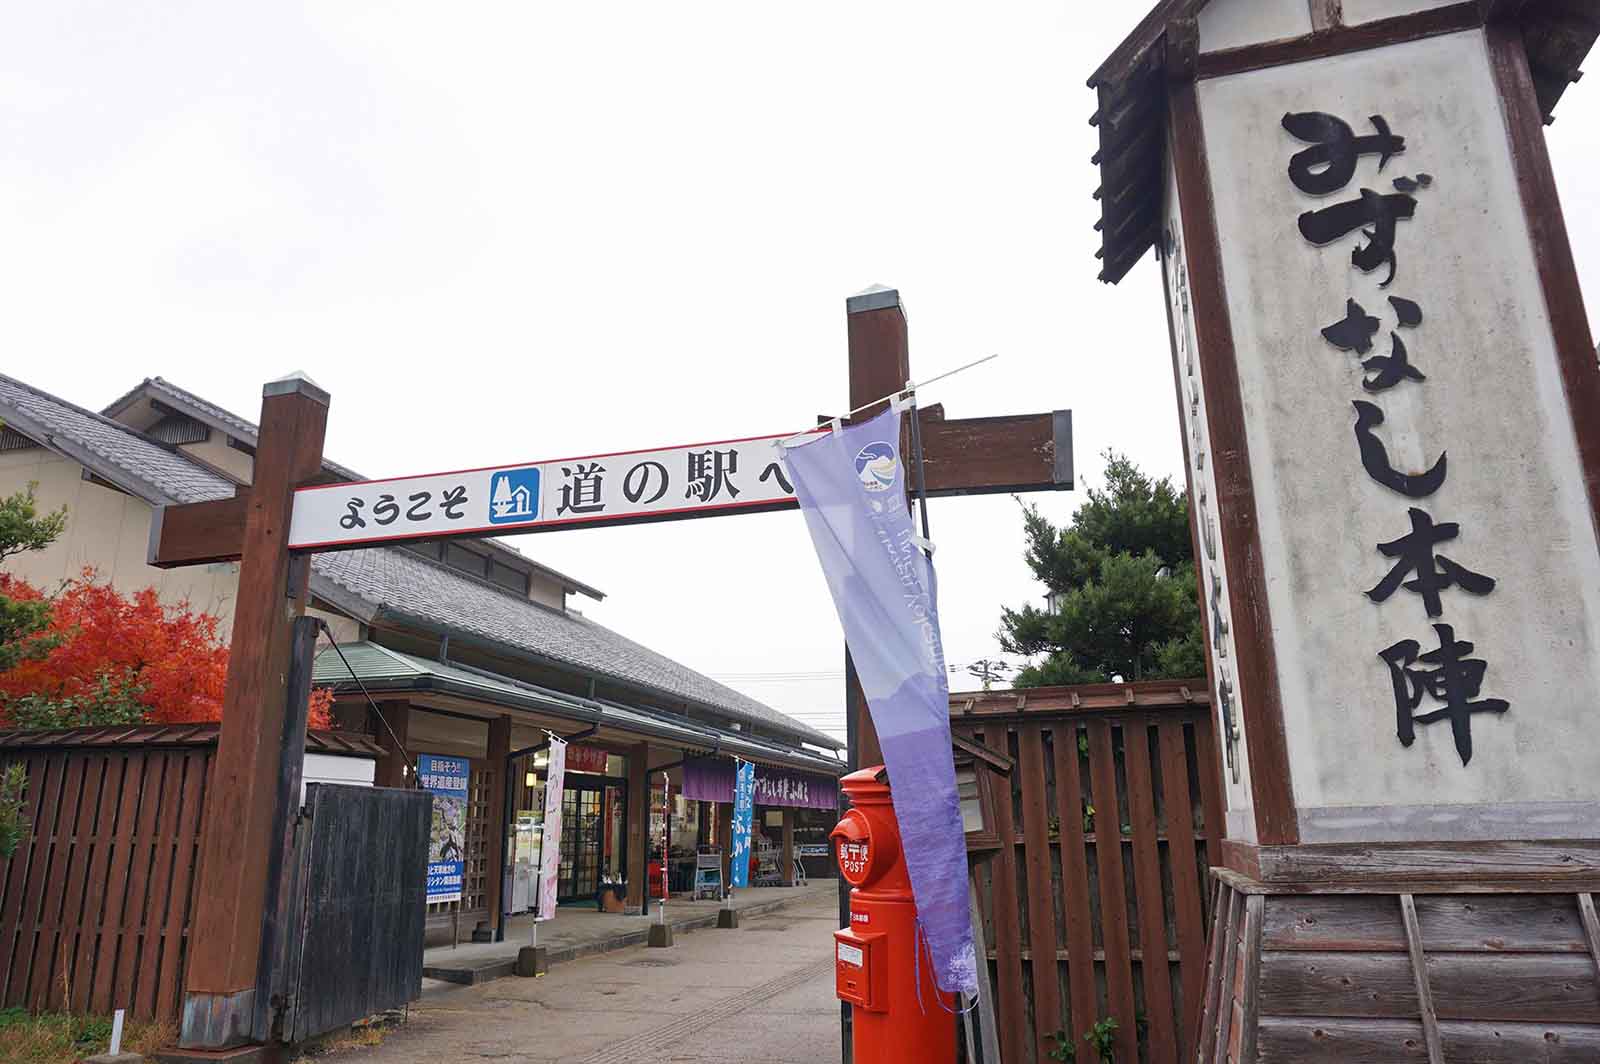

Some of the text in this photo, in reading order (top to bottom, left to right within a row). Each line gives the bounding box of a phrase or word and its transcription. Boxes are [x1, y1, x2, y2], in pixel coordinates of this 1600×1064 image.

[1281, 110, 1510, 767] みずなし本陣
[339, 448, 795, 529] ようこそ 道の駅へ
[844, 860, 865, 873] POST
